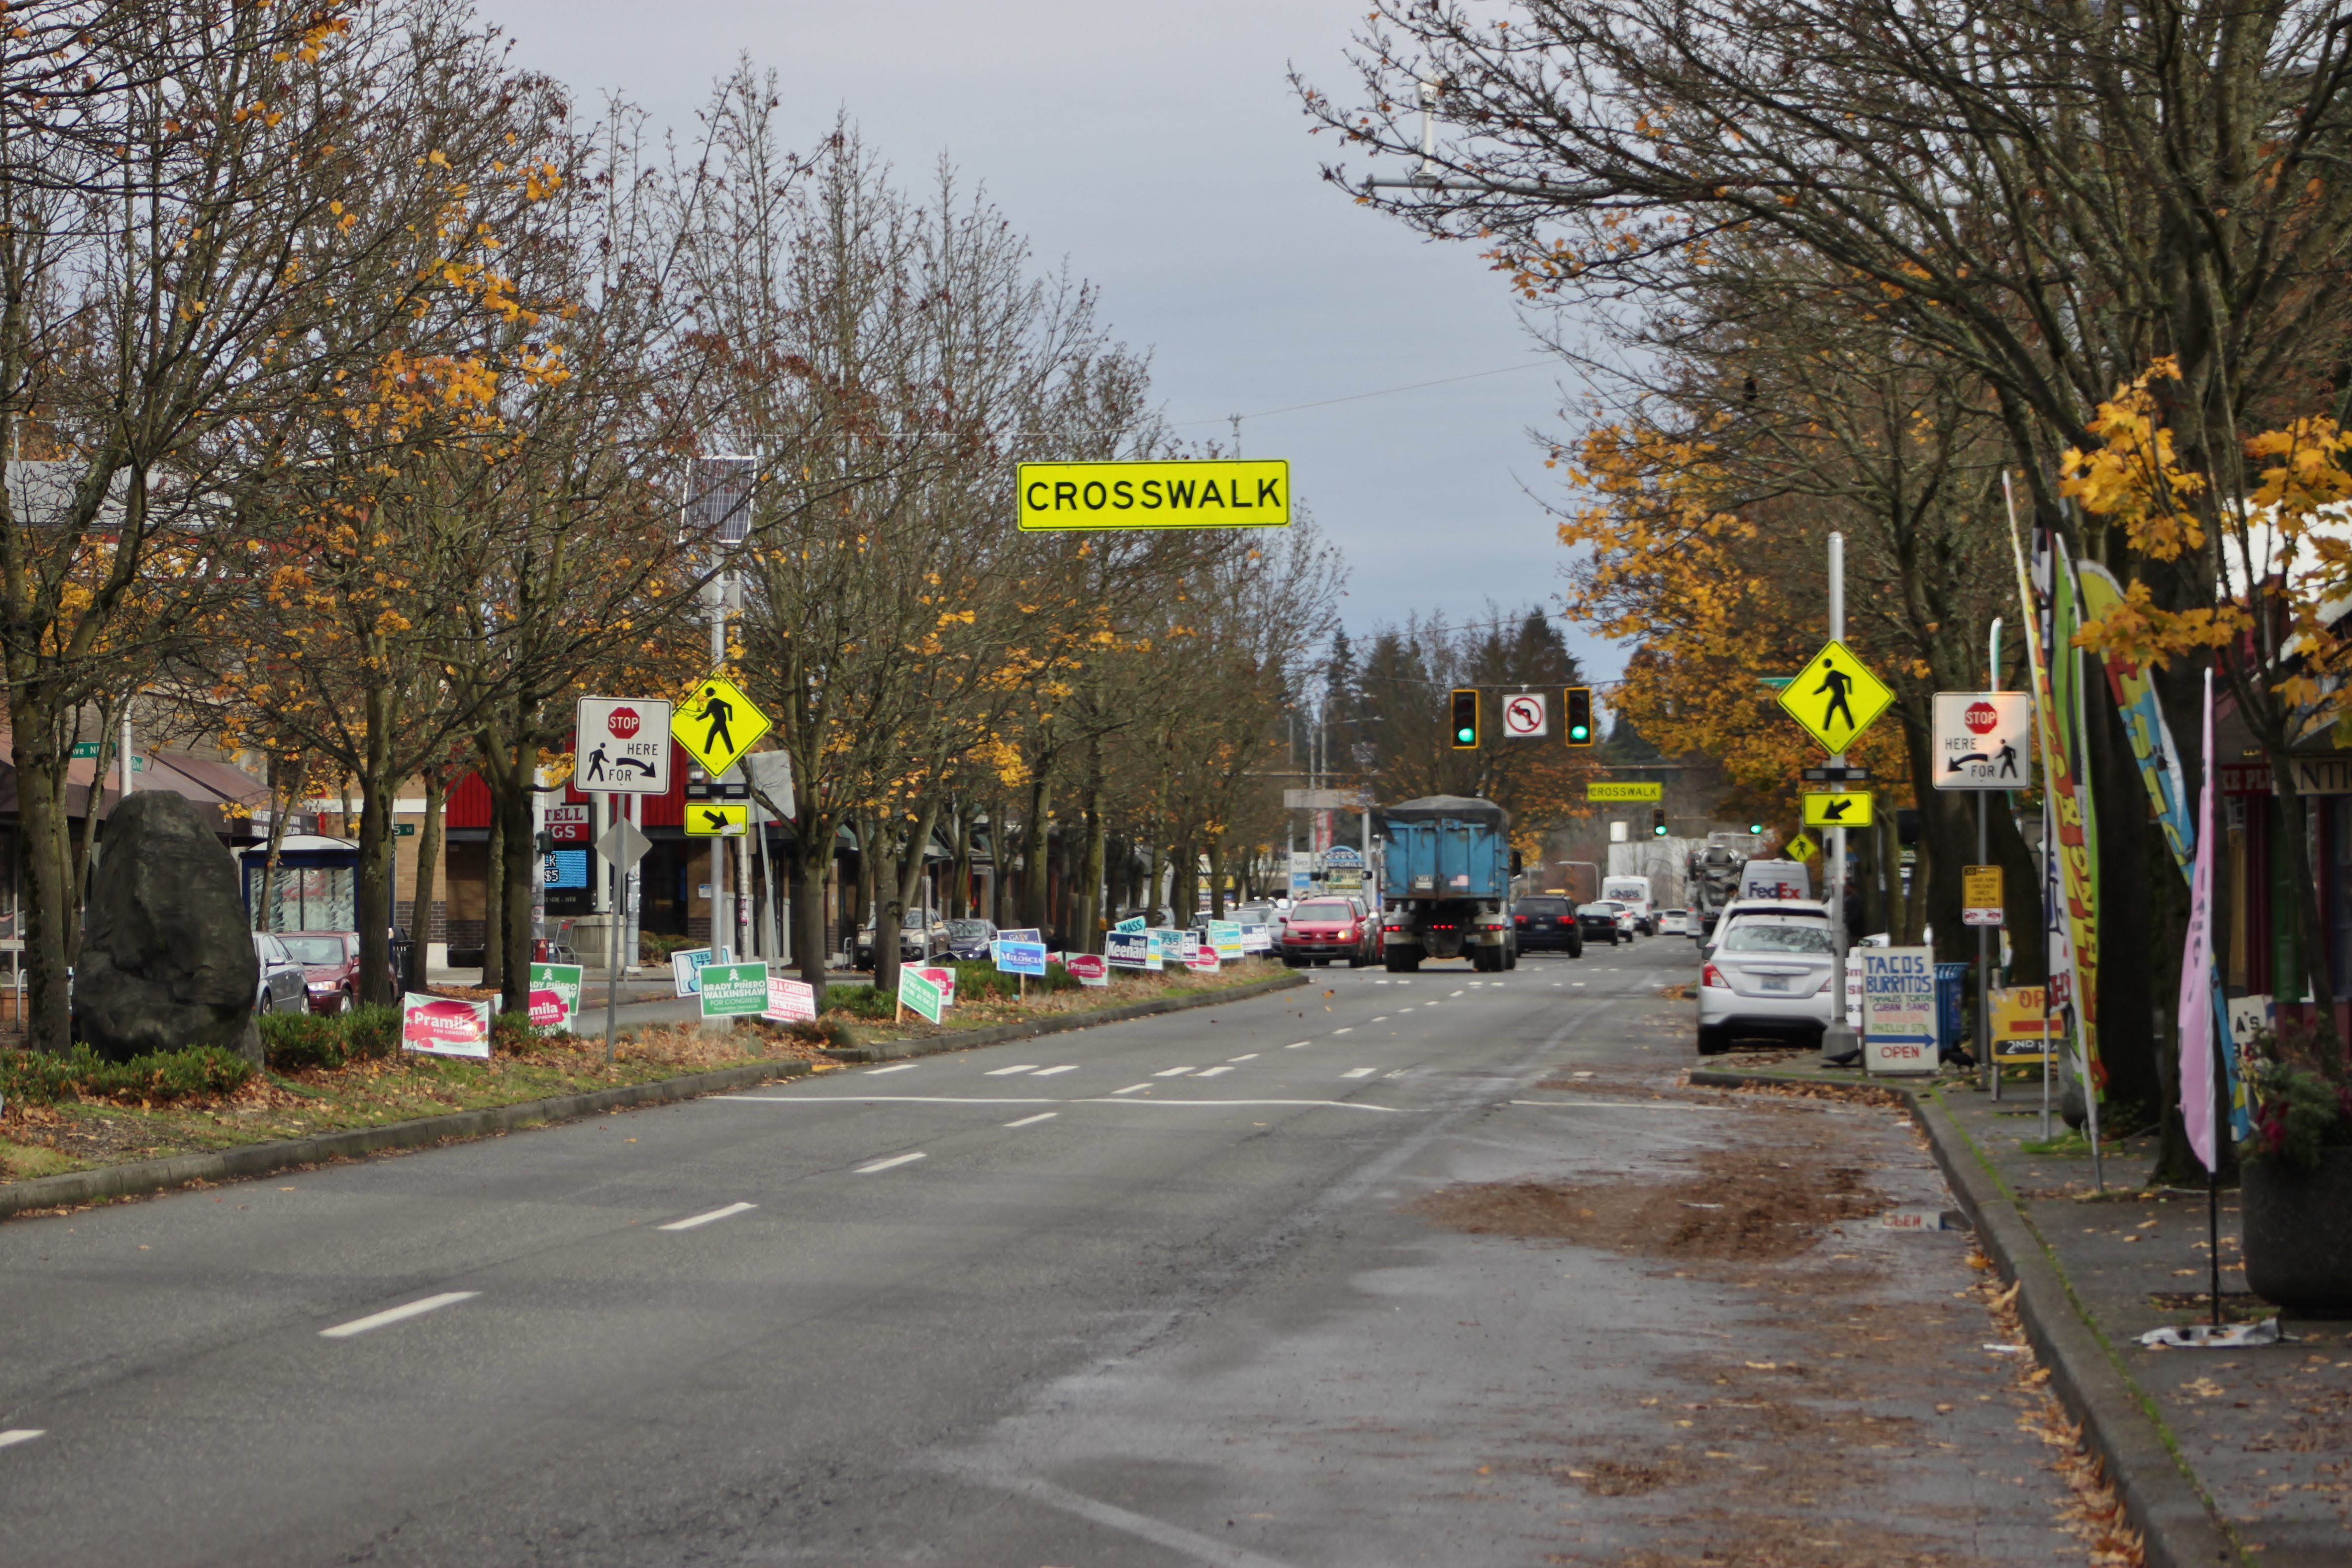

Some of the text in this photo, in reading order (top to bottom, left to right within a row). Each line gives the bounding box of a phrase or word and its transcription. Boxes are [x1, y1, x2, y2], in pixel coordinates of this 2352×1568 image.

[1027, 478, 1281, 510] CROSSWALK
[609, 717, 638, 730] STOP
[1965, 711, 1996, 725] STOP
[627, 743, 658, 755] HERE
[1945, 737, 1977, 750] HERE
[609, 769, 632, 782] FOR
[1971, 765, 1995, 778] FOR
[1590, 787, 1657, 796] CROSSWALK
[1748, 882, 1801, 899] FedEx
[1120, 920, 1143, 933] MASS
[1129, 937, 1146, 947] David
[1161, 937, 1179, 946] 735
[1214, 936, 1239, 945] MOORE
[1107, 941, 1146, 960] Keenan
[1070, 962, 1100, 972] Pramila
[1864, 956, 1924, 974] TACOS
[703, 979, 766, 991] BRADY PIÑERO
[1865, 976, 1932, 993] BURRITOS
[703, 987, 766, 999] WALKINSHAW
[529, 1002, 558, 1016] mila
[1873, 1003, 1930, 1012] CUBAN SAND
[415, 1011, 474, 1030] Pramila
[1874, 1012, 1924, 1023] BURGERS
[1872, 1024, 1906, 1033] PHILLY
[1881, 1046, 1920, 1059] OPEN
[2006, 1040, 2035, 1054] 2ND
